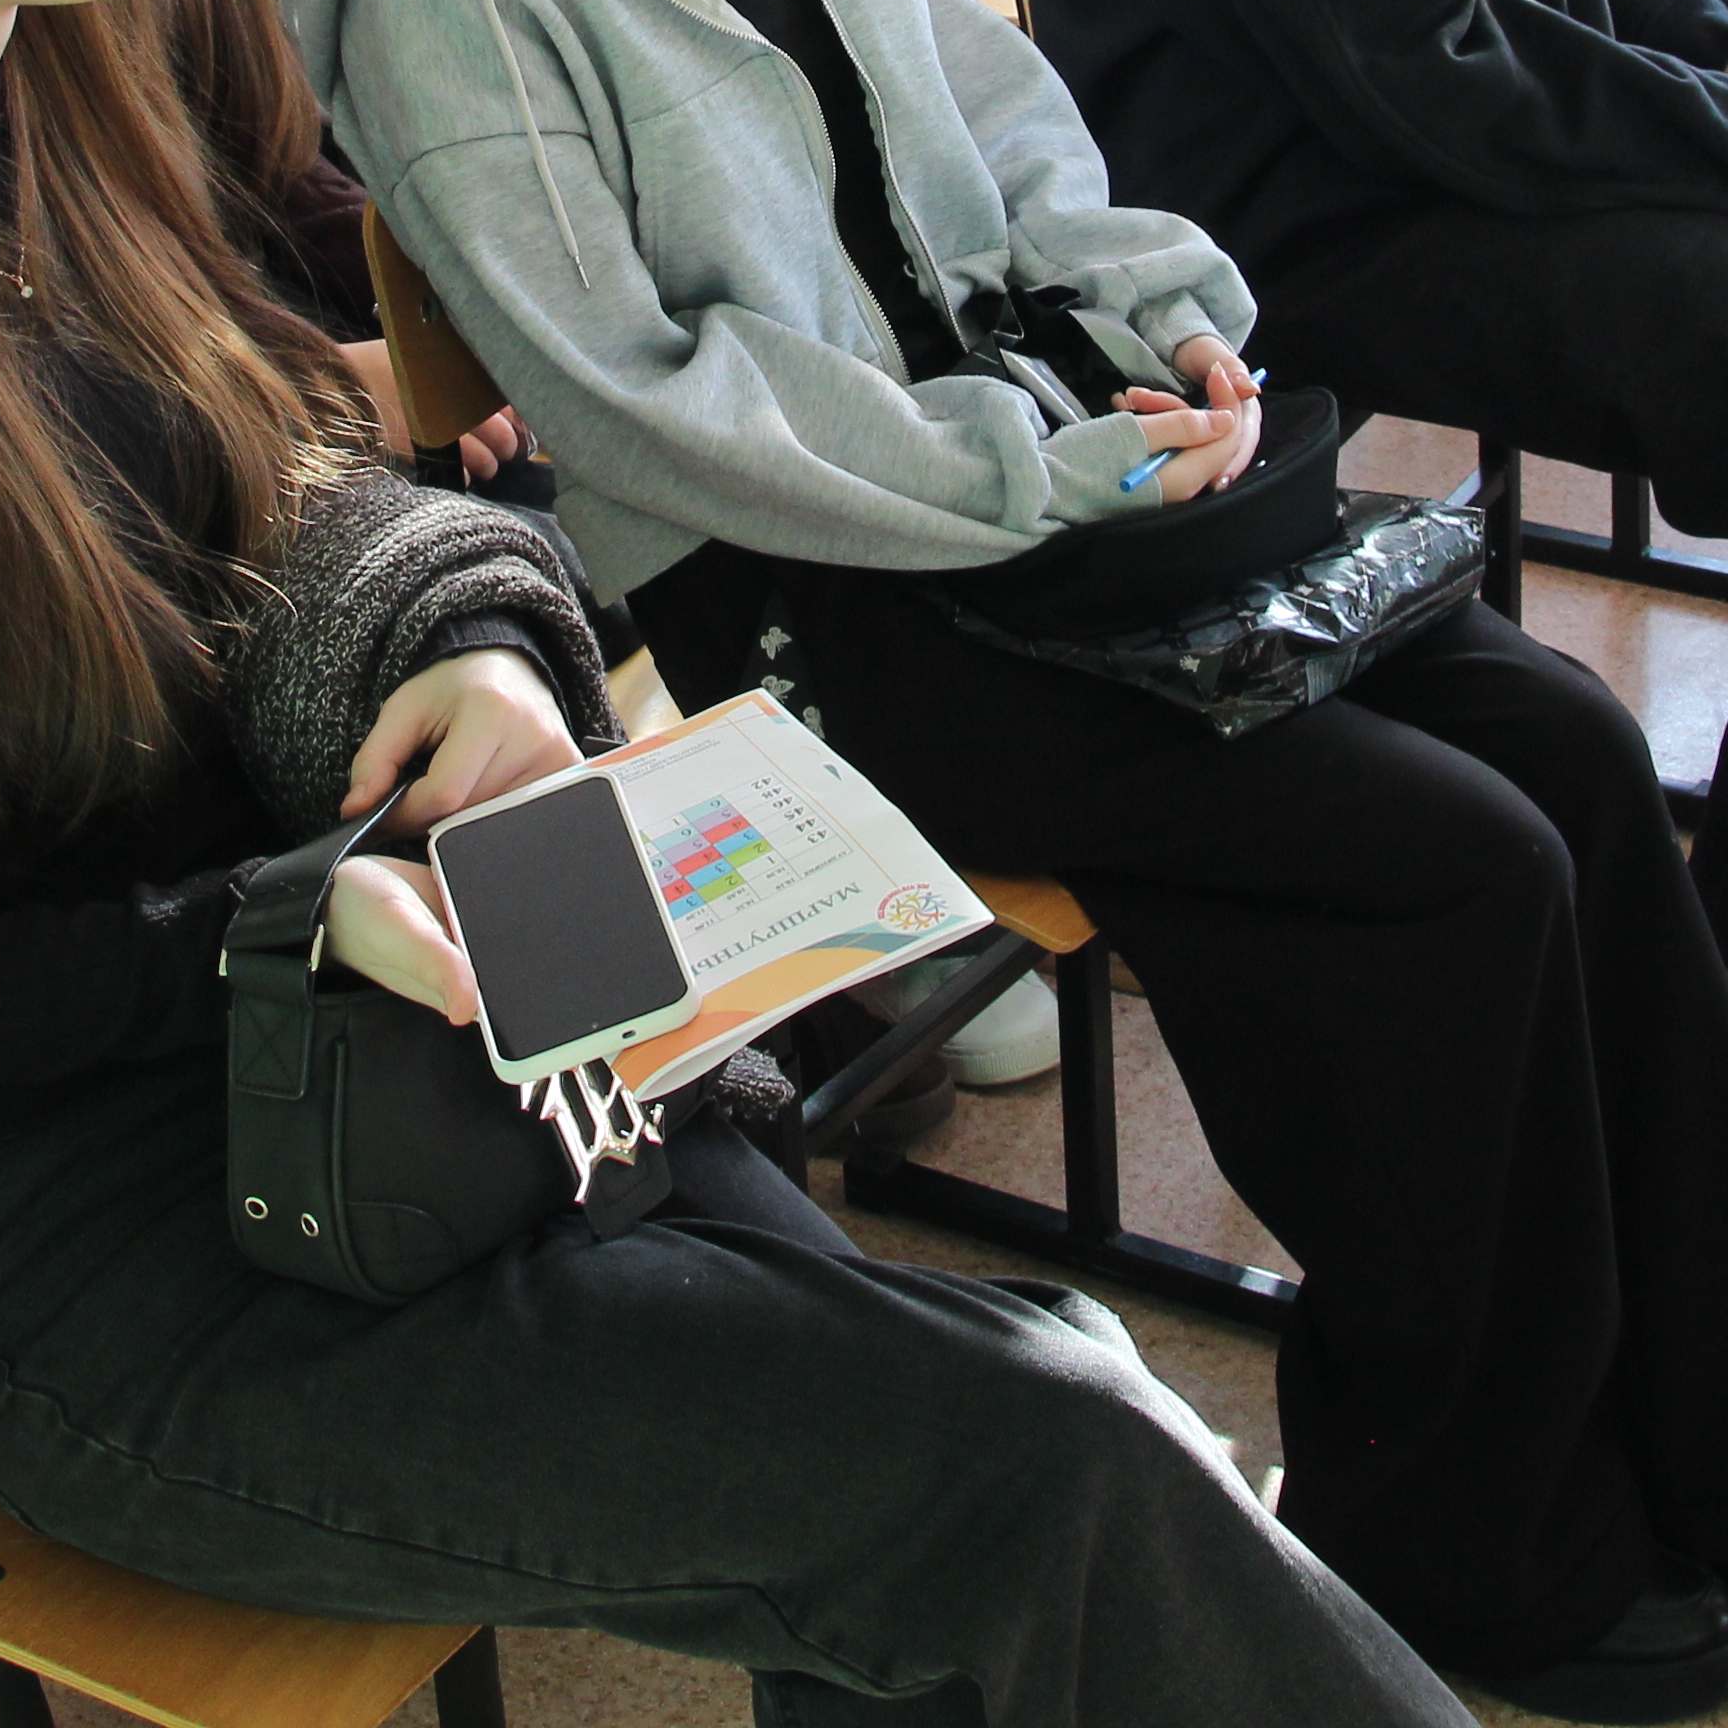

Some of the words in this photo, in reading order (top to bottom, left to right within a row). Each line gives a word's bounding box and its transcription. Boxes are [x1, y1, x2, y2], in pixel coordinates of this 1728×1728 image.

[751, 776, 772, 790] 42
[762, 786, 783, 800] 48
[710, 799, 721, 809] 6
[772, 795, 793, 809] 46
[721, 809, 731, 819] 5
[783, 806, 805, 821] 45
[732, 821, 742, 829] 4
[795, 817, 816, 833] 44
[681, 827, 692, 837] 6
[743, 830, 754, 840] 3
[807, 829, 828, 844] 43
[692, 839, 703, 850] 5
[753, 842, 767, 853] 2
[703, 851, 713, 860] 4
[652, 859, 663, 870] 6
[715, 862, 726, 873] 3
[663, 870, 674, 881] 5
[724, 875, 738, 887] 2
[674, 884, 684, 894] 4
[686, 895, 698, 907] 3
